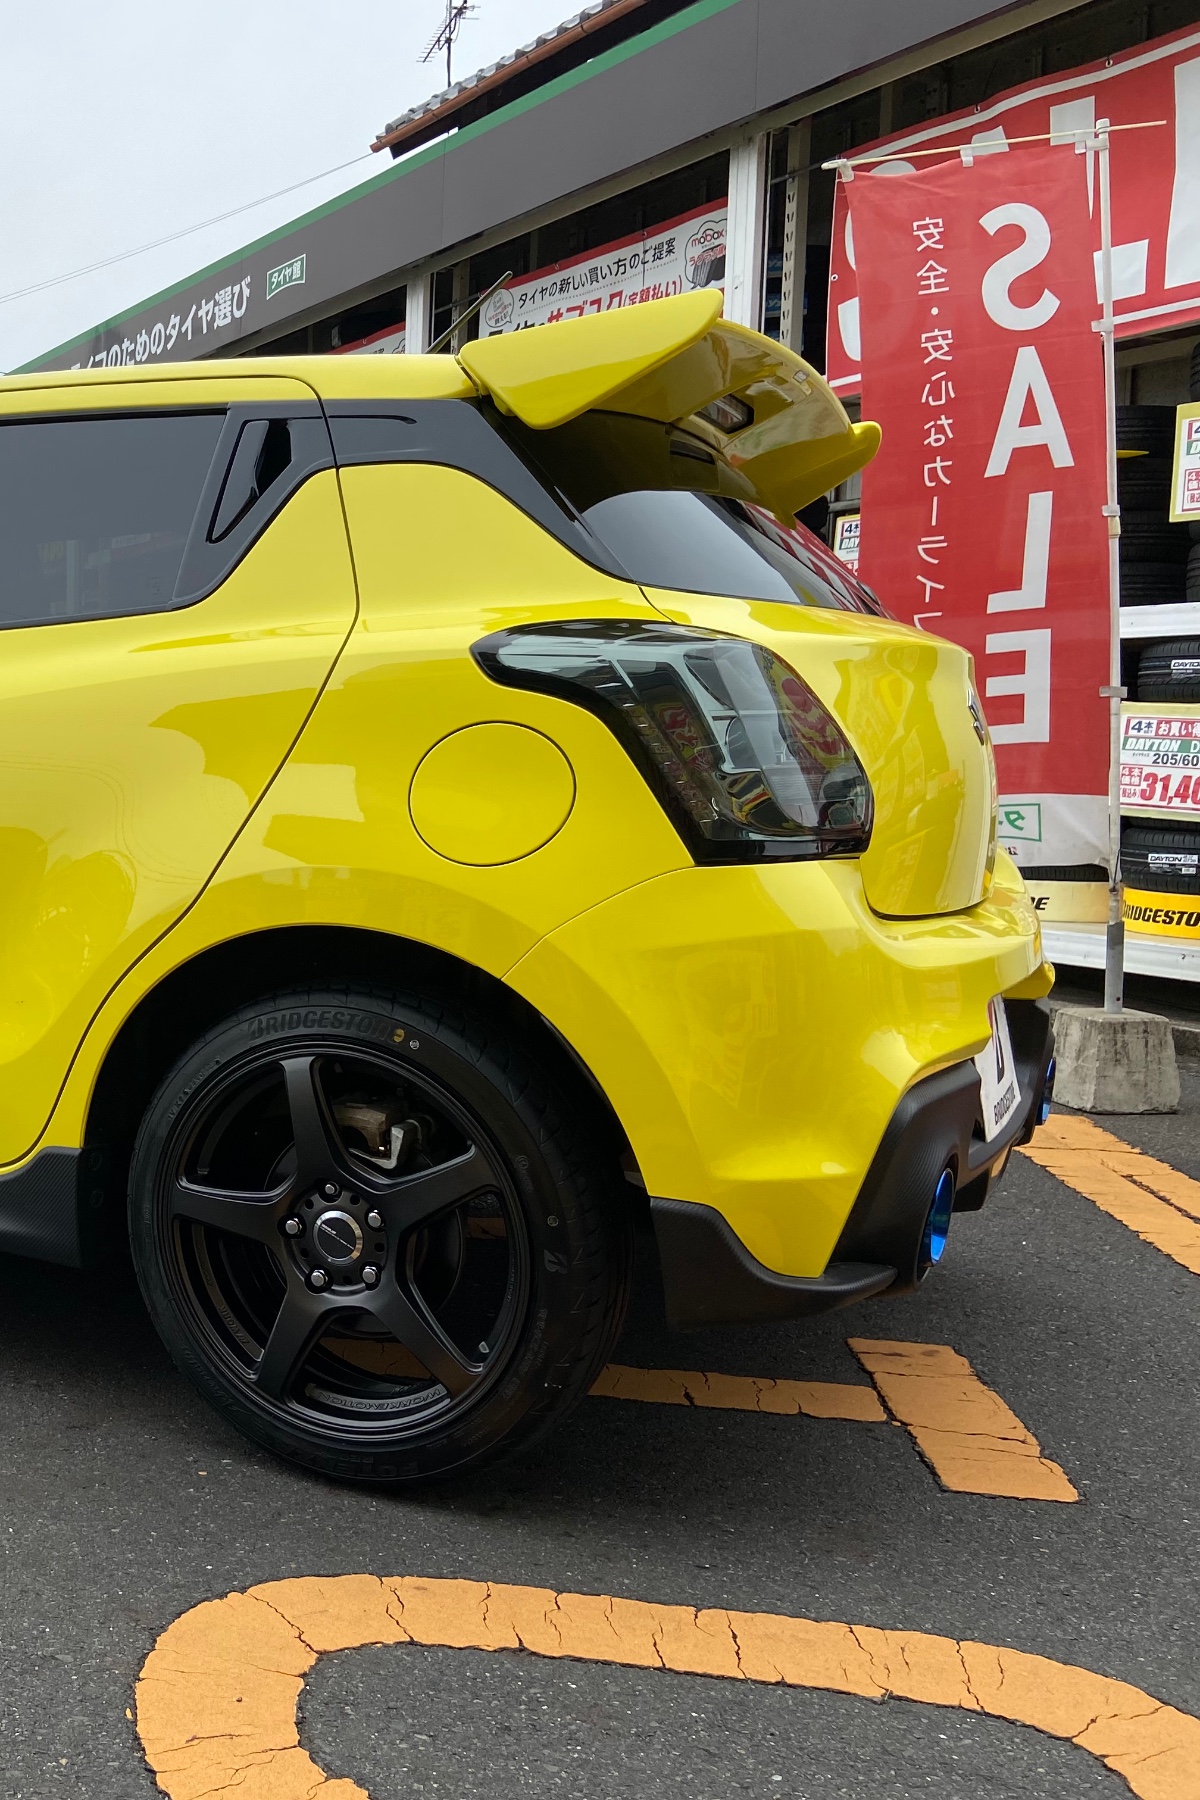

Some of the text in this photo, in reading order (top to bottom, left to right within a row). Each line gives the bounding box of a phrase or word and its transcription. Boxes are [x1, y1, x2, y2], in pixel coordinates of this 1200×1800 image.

[271, 260, 302, 290] タイヤ館
[518, 237, 676, 310] タイヤの新しい買い方のご提案
[1125, 738, 1182, 752] DAYTON
